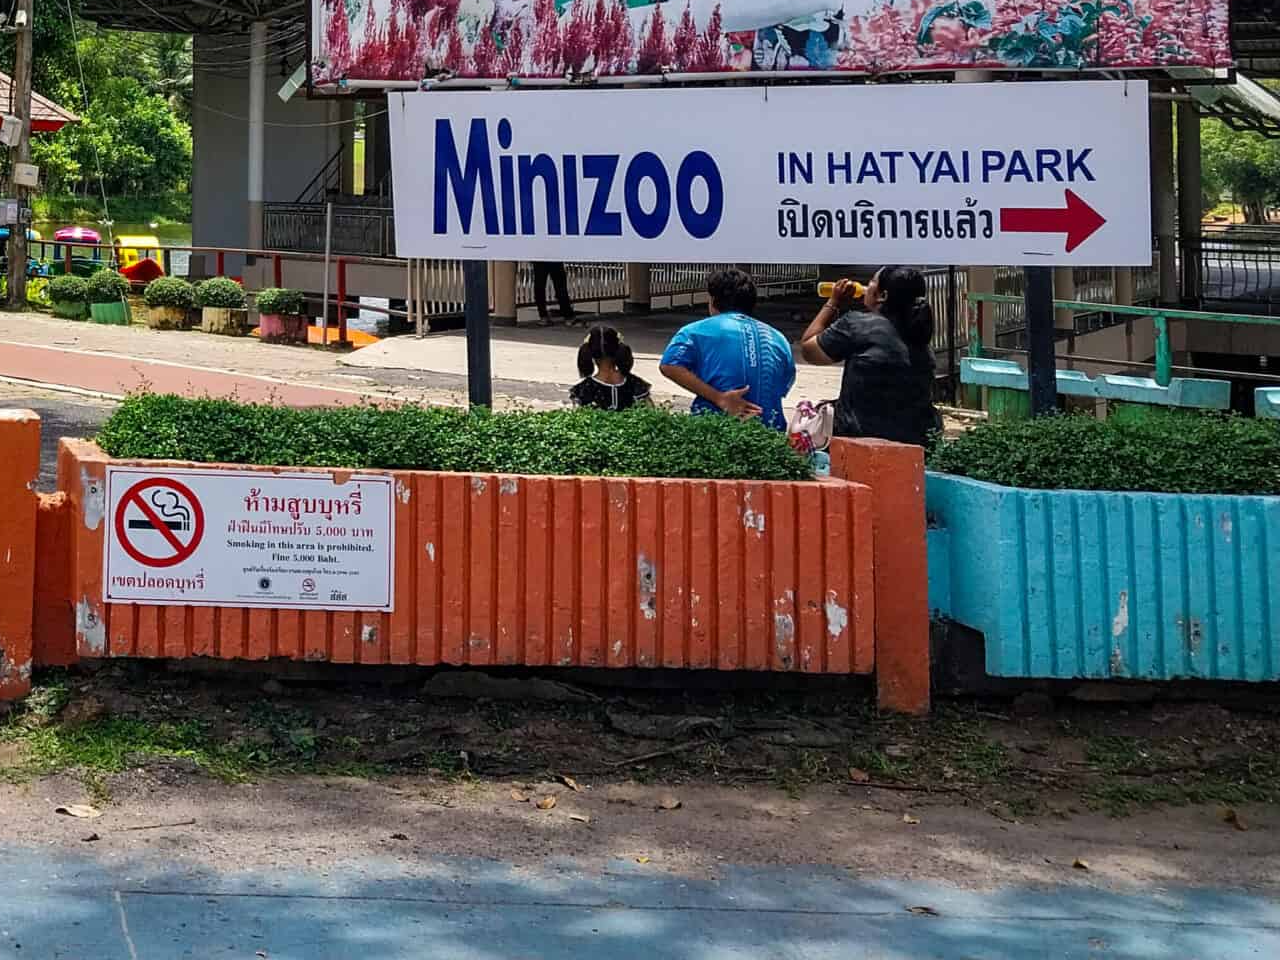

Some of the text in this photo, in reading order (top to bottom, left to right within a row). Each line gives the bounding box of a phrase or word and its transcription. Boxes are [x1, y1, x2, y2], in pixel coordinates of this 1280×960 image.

[777, 151, 814, 185] IN
[982, 148, 1097, 183] PARK
[777, 197, 994, 240] เปิดบริการแล้ว
[243, 484, 363, 521] ห้ามสูบบุหรี่
[227, 540, 265, 550] Smoking
[267, 541, 276, 549] in
[278, 541, 294, 550] this
[317, 542, 325, 551] is
[351, 527, 374, 537] บาท
[112, 568, 205, 594] เขตปลอดบุหรี่
